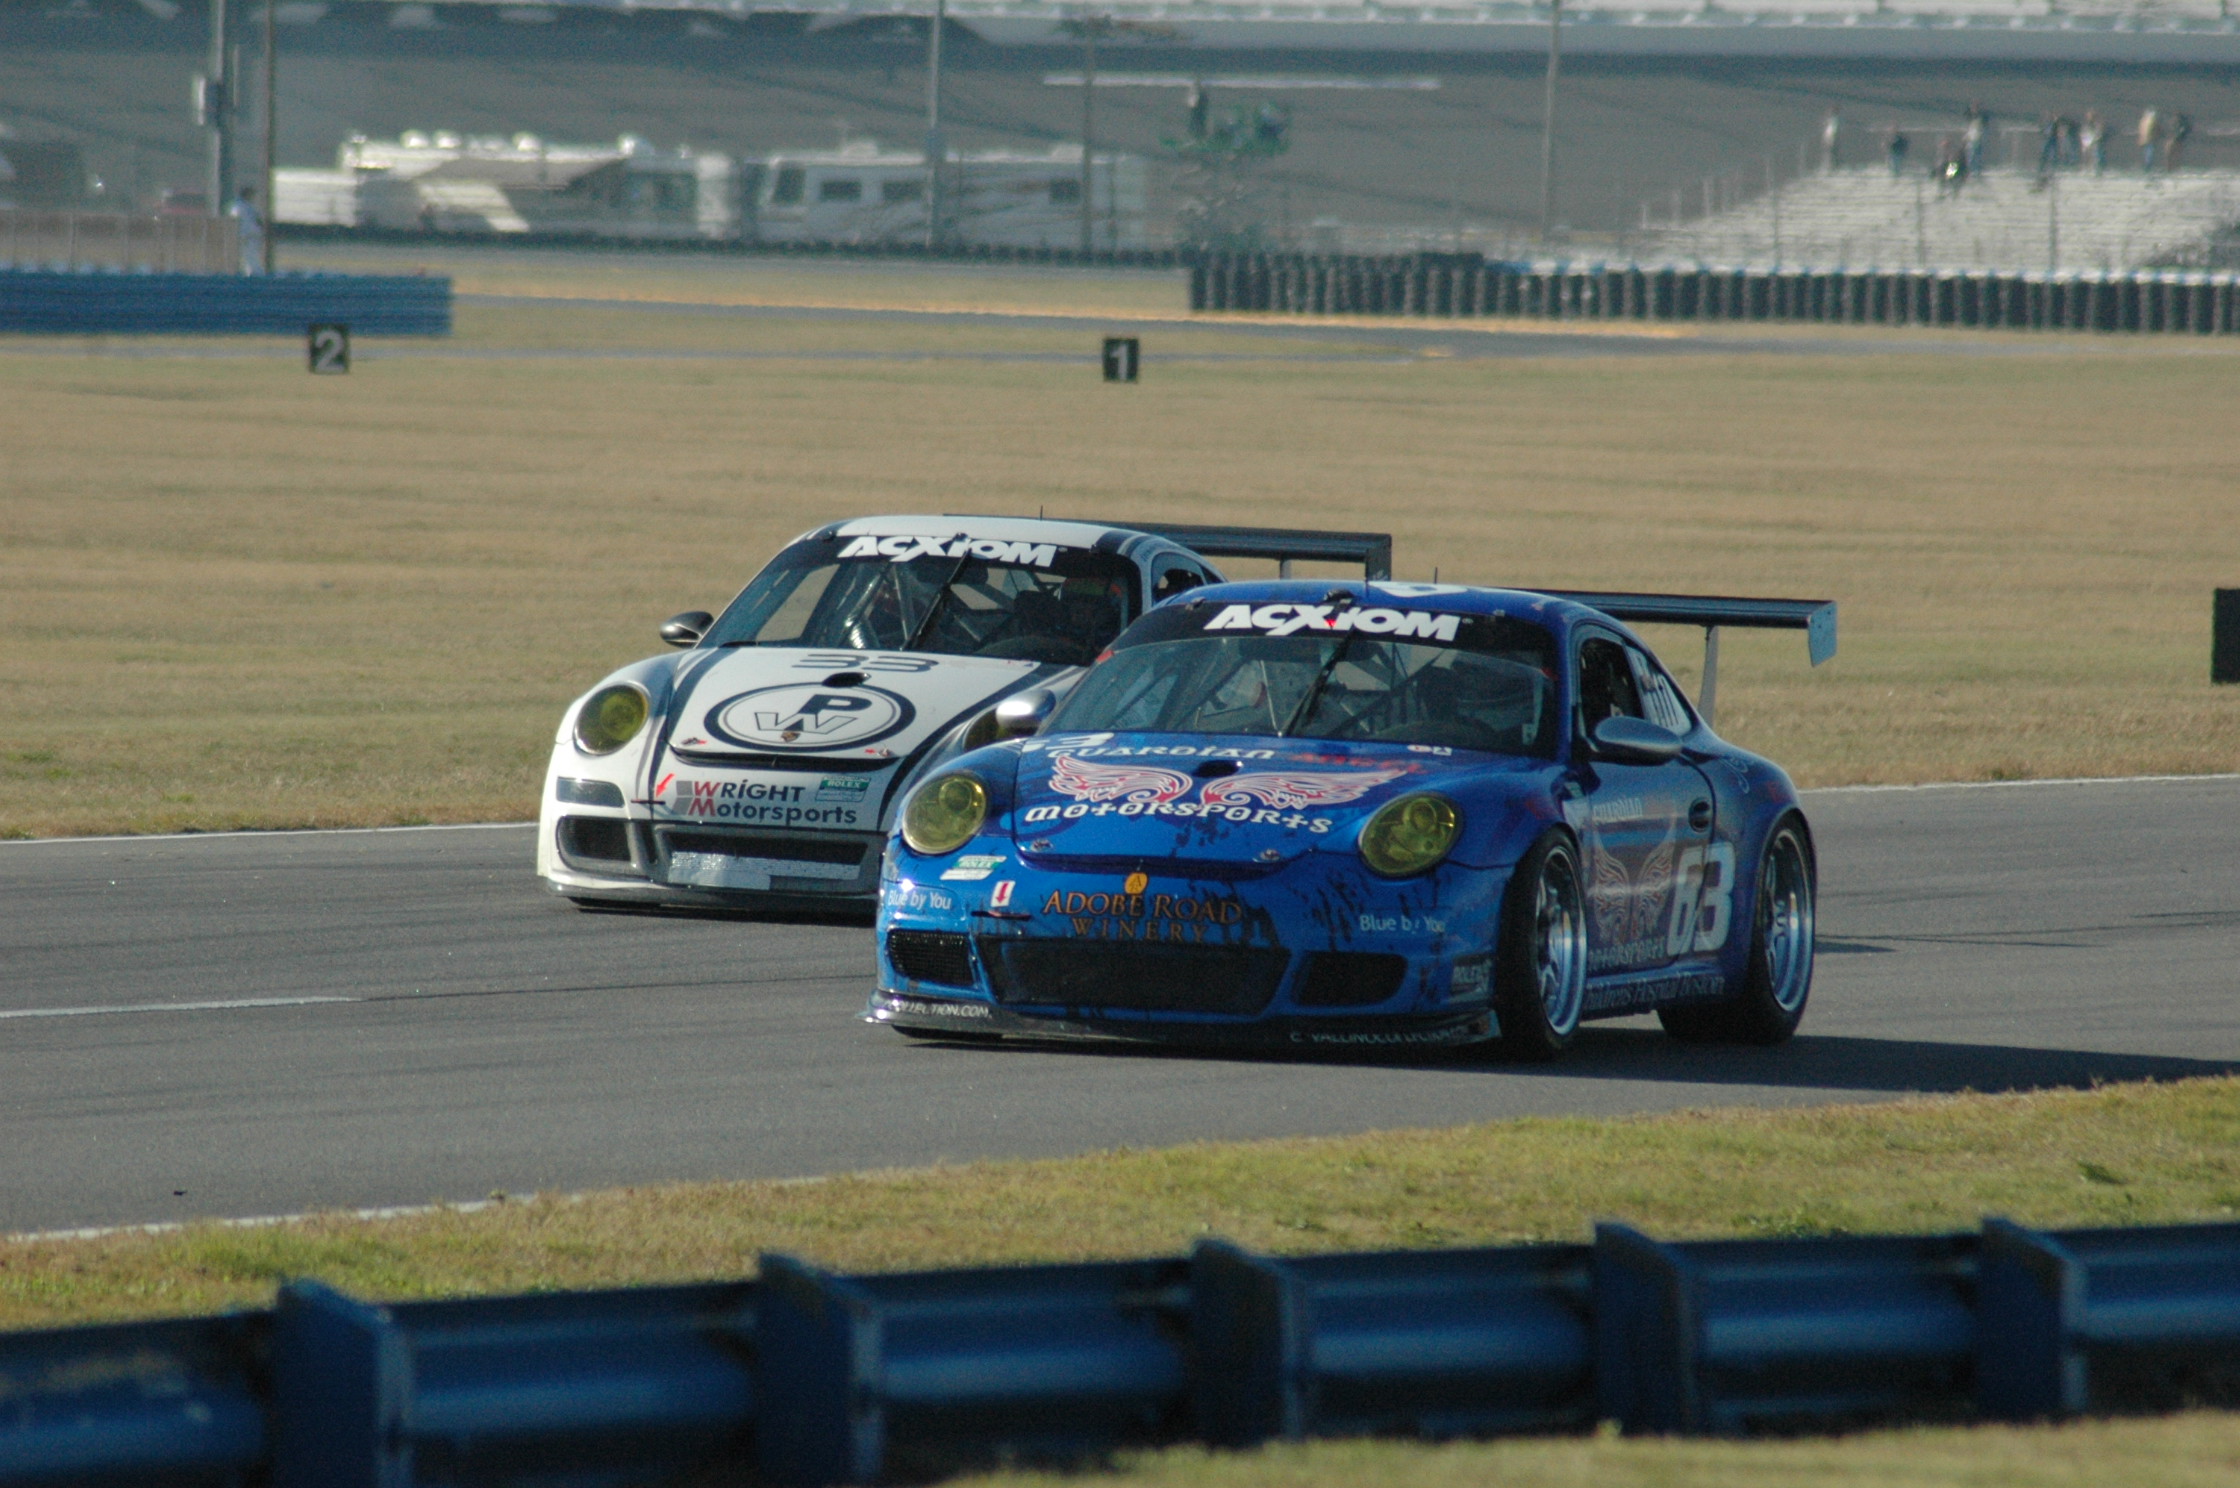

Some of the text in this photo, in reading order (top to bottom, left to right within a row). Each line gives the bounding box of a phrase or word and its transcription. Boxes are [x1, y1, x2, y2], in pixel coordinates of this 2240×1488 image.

[315, 329, 345, 371] 2
[1110, 344, 1128, 379] 1
[791, 653, 939, 673] 33
[688, 797, 857, 826] Motorsports
[1025, 803, 1333, 834] MOTORSPORTS
[910, 891, 927, 910] by
[929, 892, 951, 910] You
[1043, 889, 1242, 925] ADOBE ROAD
[1667, 841, 1736, 957] 63
[1072, 917, 1208, 943] WINERY
[1360, 914, 1397, 932] Blue
